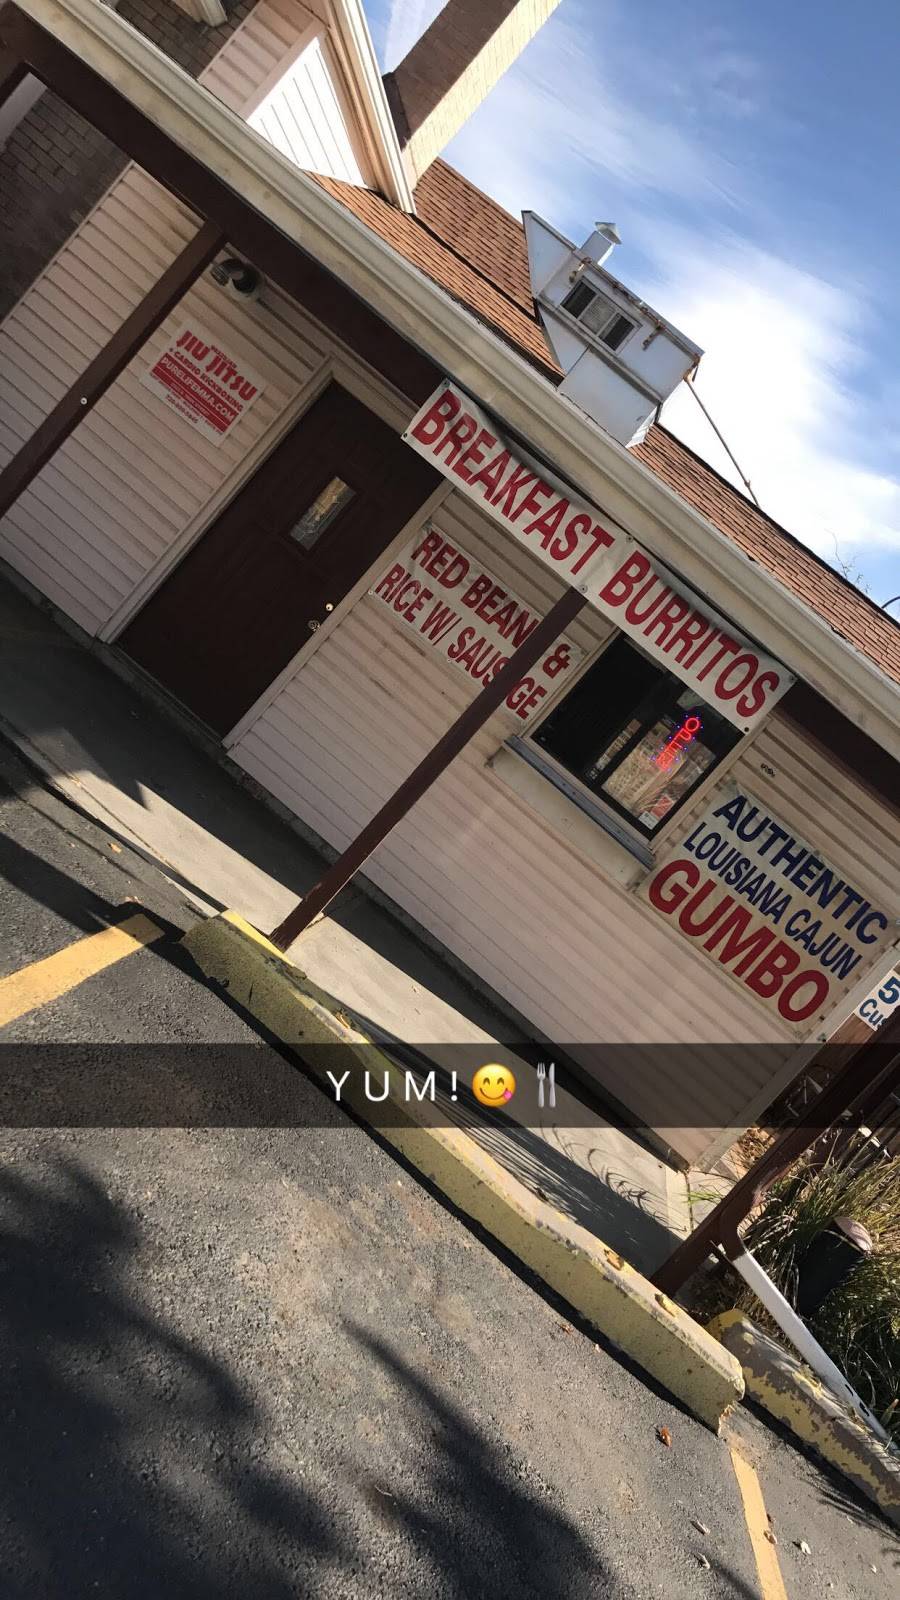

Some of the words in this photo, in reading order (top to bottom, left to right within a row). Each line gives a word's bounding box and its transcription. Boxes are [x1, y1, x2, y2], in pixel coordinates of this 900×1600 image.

[160, 356, 235, 419] PURELIFEMMA.COM
[174, 351, 201, 376] CARDIO
[200, 372, 244, 412] KICKBOXING
[176, 330, 211, 362] JIU
[205, 355, 258, 401] JITSU
[410, 388, 616, 576] BREAKFAST
[598, 550, 780, 718] BURRITOS
[410, 531, 470, 589] RED
[542, 643, 571, 679] &
[374, 563, 434, 623] RICE
[420, 600, 463, 646] W/
[447, 626, 548, 720] SAUSGE
[649, 859, 830, 1022] GUMBO
[683, 822, 793, 925] LOUISIANA
[784, 909, 863, 981] CAJUN
[712, 795, 888, 944] AUTHENTIC
